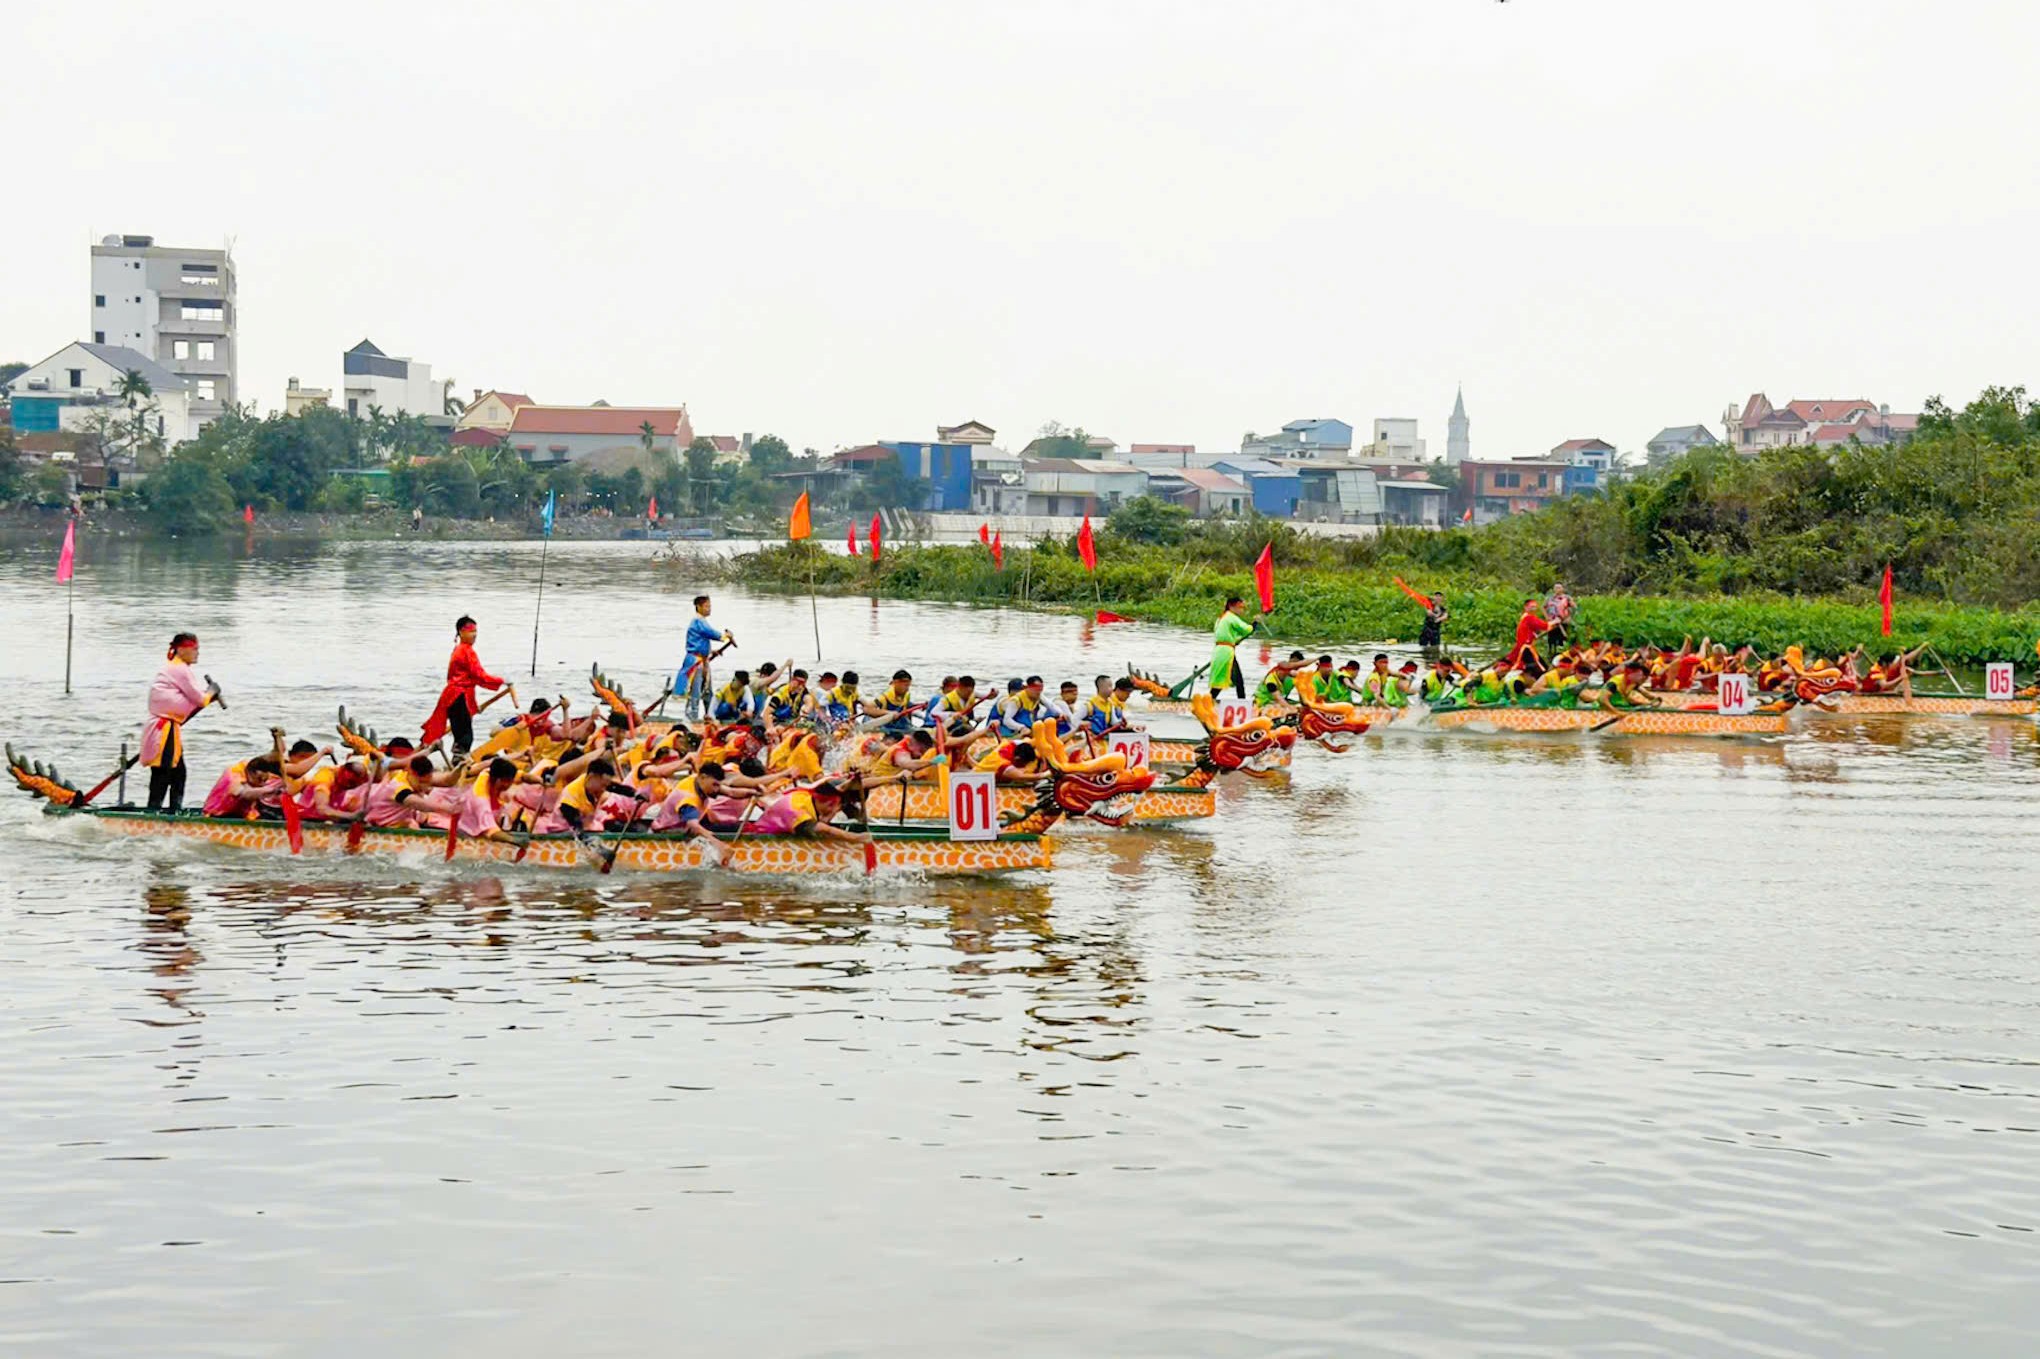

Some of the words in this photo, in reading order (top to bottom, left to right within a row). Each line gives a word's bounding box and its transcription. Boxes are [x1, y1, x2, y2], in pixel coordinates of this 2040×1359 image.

[1723, 680, 1744, 708] 04
[1990, 669, 2009, 694] 05
[956, 782, 990, 831] 01
